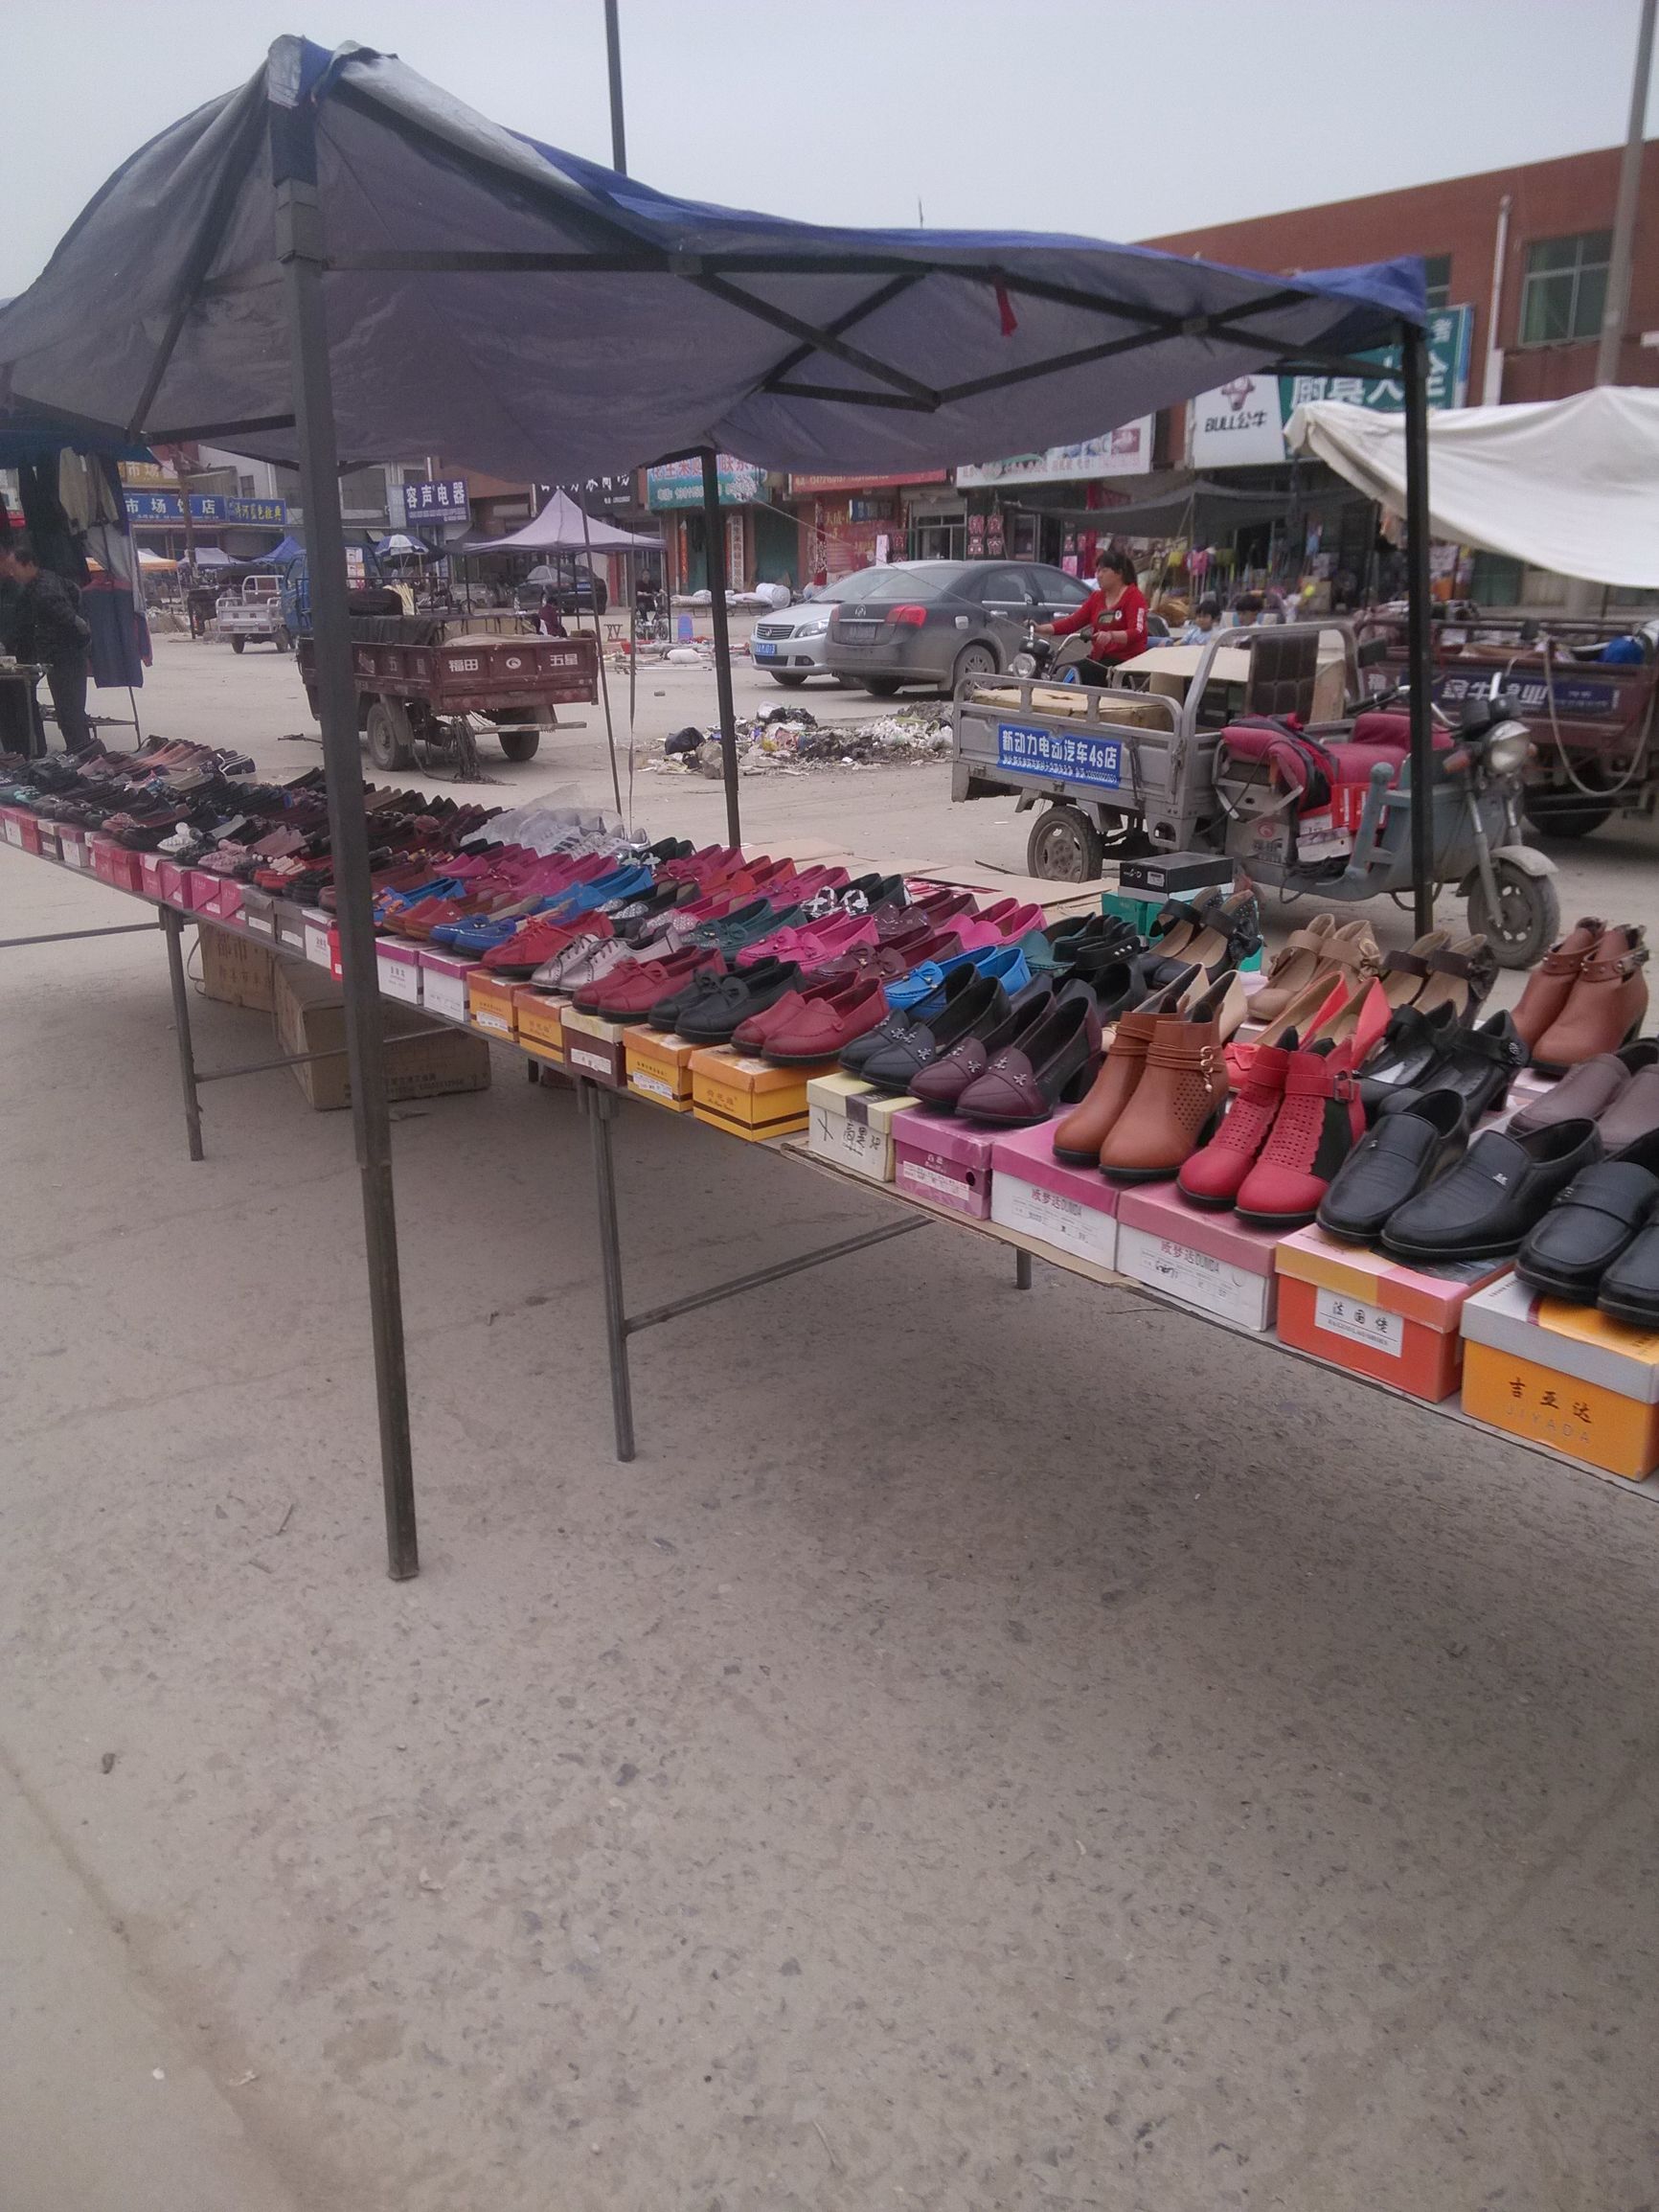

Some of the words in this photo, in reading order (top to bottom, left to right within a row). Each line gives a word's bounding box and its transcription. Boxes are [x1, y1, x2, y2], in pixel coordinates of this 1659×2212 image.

[406, 481, 466, 509] 容声电器
[448, 658, 479, 673] 福田
[549, 652, 579, 667] 五星
[1509, 1376, 1592, 1425] 吉亚达
